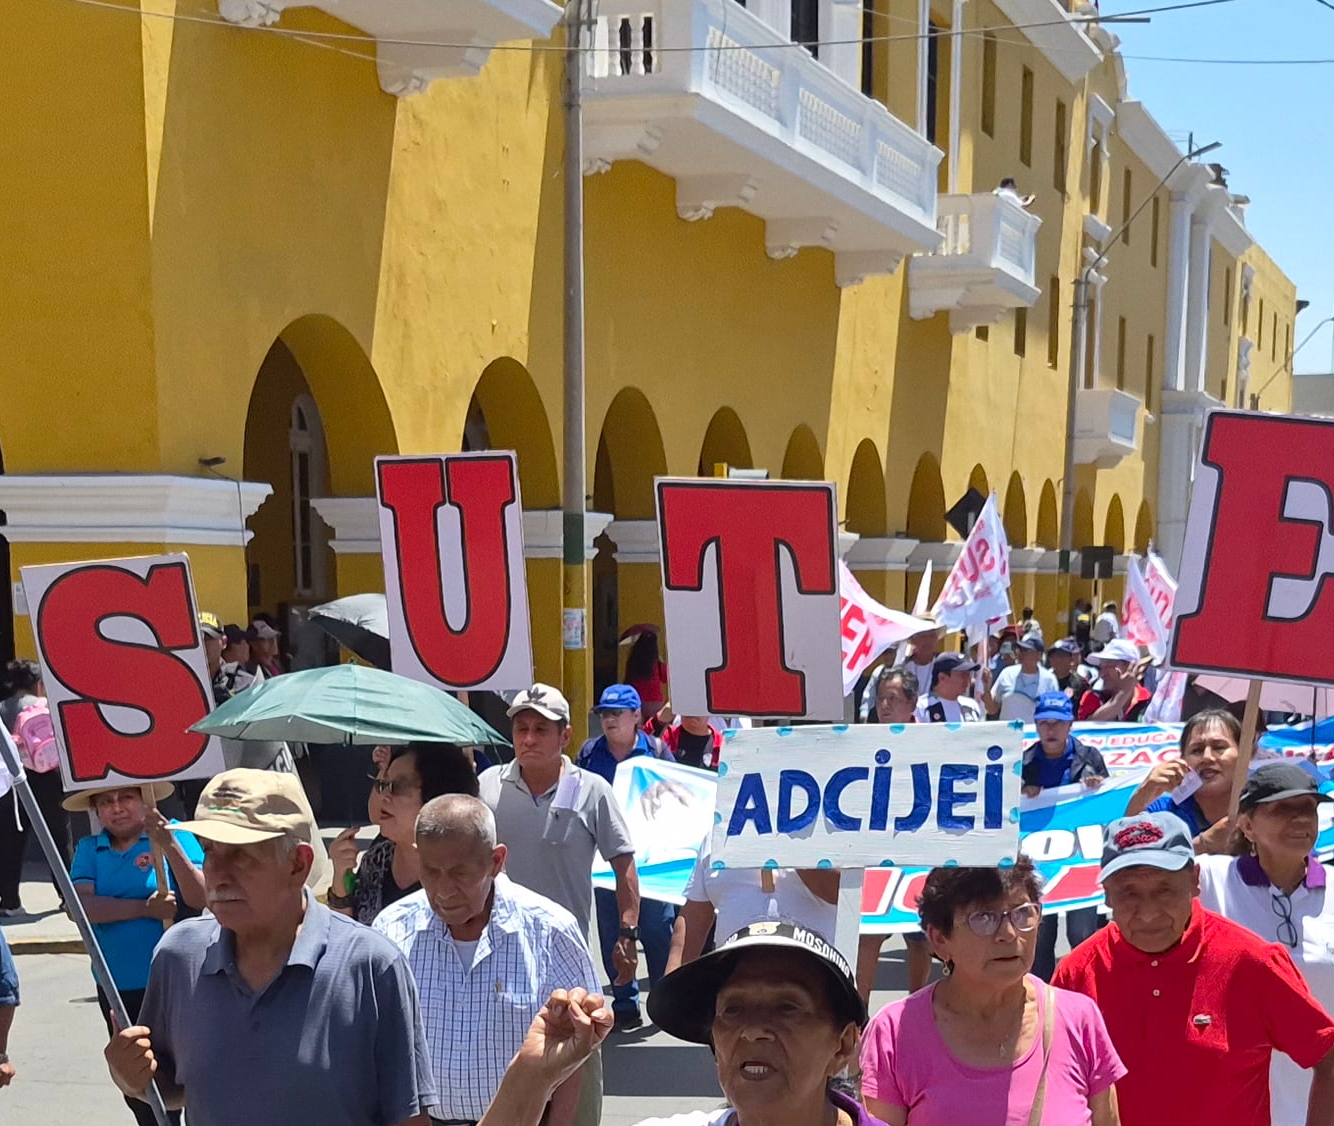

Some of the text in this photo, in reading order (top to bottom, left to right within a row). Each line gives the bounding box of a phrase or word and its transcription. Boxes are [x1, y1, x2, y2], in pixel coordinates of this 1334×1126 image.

[36, 562, 211, 782] S
[377, 454, 516, 686] U
[657, 483, 836, 717] T
[726, 744, 1004, 838] ADCIJEI
